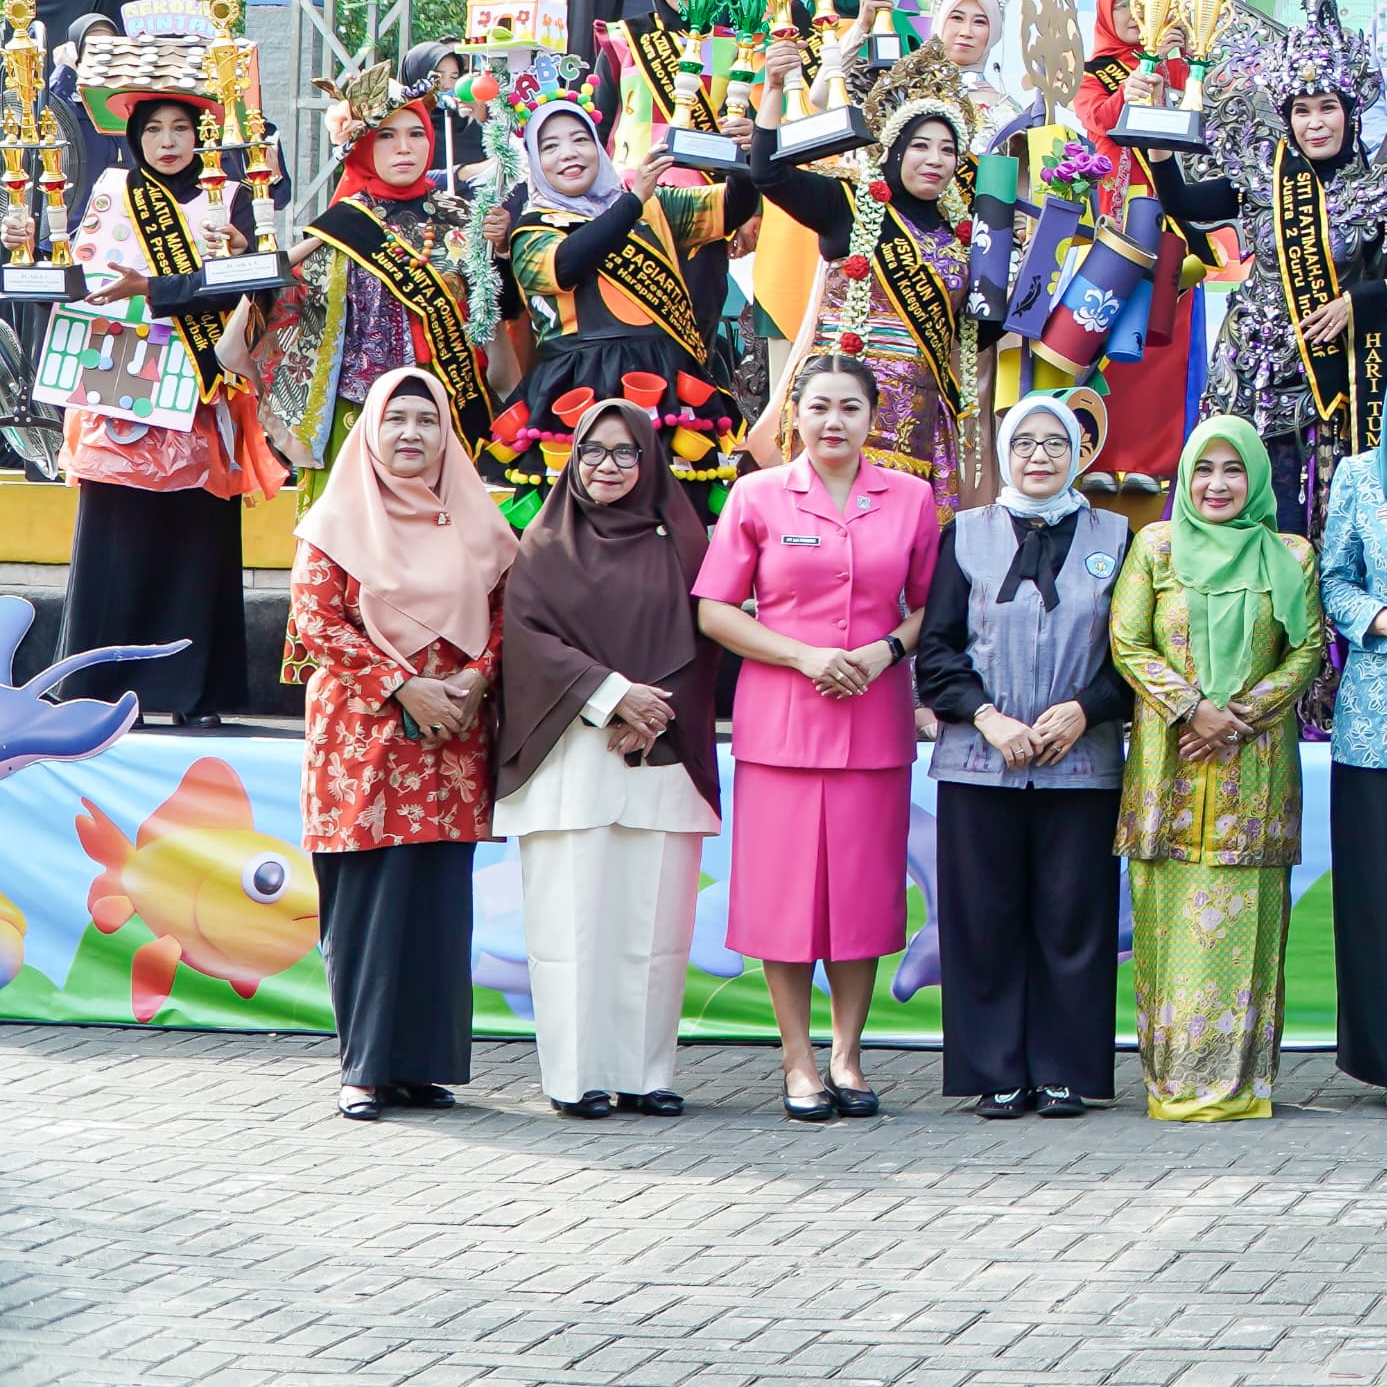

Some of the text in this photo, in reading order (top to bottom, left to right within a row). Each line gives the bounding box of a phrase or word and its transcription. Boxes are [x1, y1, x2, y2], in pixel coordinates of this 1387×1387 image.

[1282, 176, 1295, 220] Juara
[1296, 172, 1313, 200] SITI
[146, 223, 158, 234] 2
[1285, 229, 1298, 239] 2
[165, 233, 195, 279] MAHMU
[628, 264, 636, 272] 1
[880, 241, 898, 270] Juara
[893, 237, 936, 302] USWATUN
[893, 271, 904, 280] 1
[1288, 246, 1306, 288] Guru
[371, 252, 404, 281] Juara
[402, 283, 414, 294] 3
[412, 294, 451, 361] Presentasi
[617, 267, 660, 306] Harapan
[661, 305, 669, 315] 2
[898, 280, 930, 323] Kategori
[1364, 332, 1383, 393] HARI
